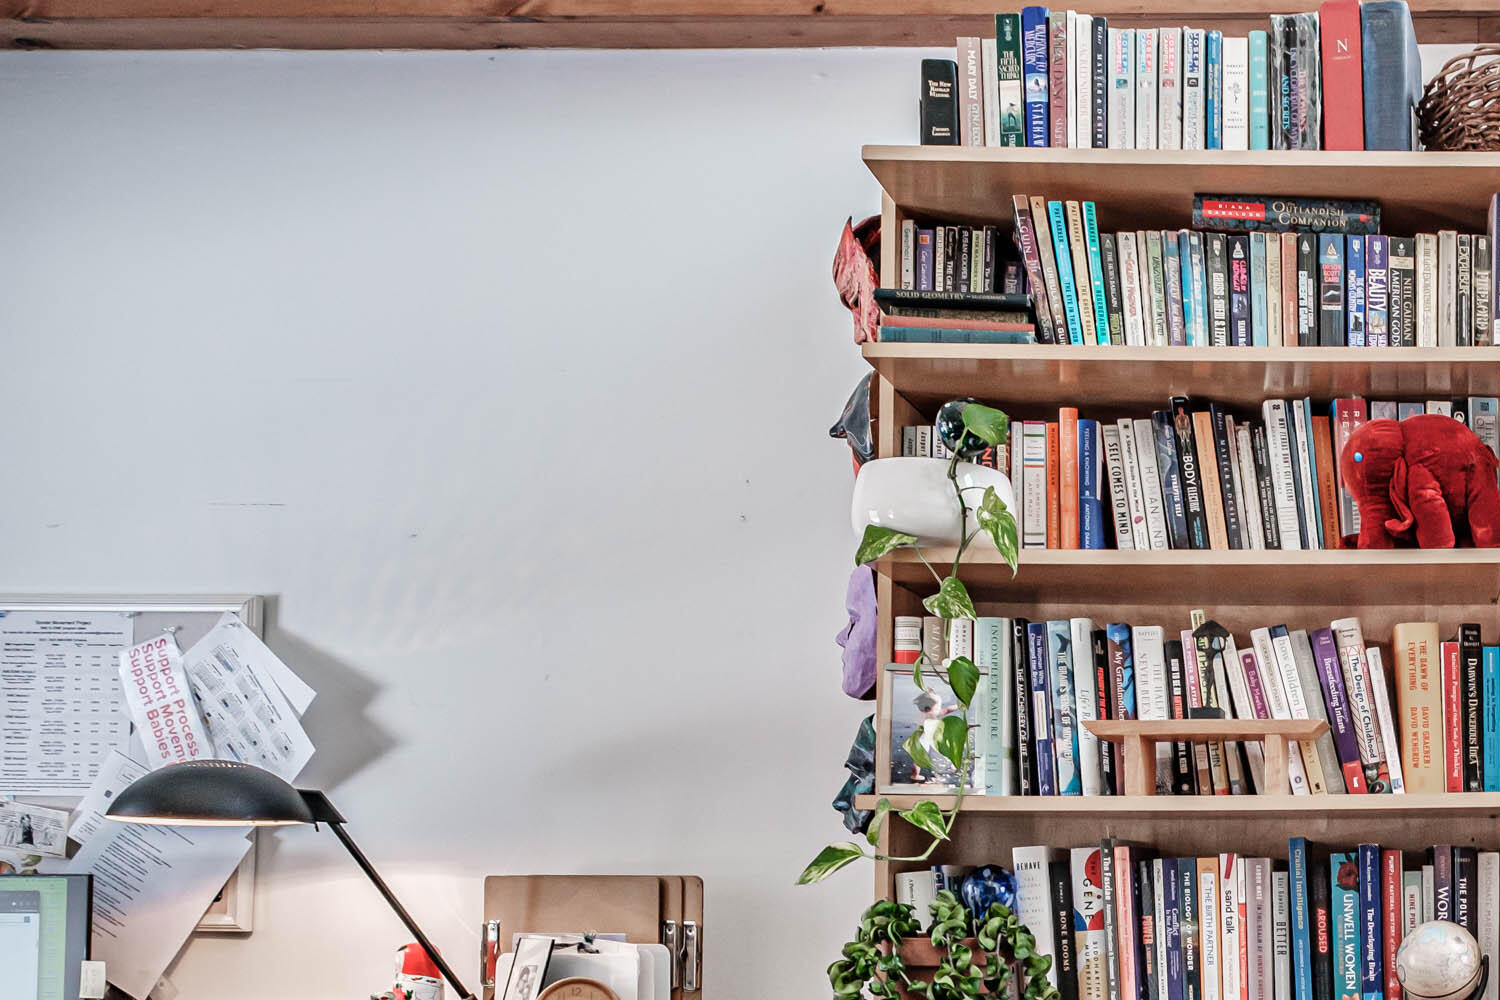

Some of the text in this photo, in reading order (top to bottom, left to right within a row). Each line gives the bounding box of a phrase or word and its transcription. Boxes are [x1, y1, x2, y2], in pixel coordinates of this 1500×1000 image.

[1025, 30, 1036, 66] MERCURY
[1035, 24, 1046, 71] WALKING TO
[1337, 38, 1348, 53] N
[968, 50, 976, 100] MARY DALY
[1032, 103, 1044, 146] STARHAW
[1272, 201, 1345, 216] OUTLANDISH
[1279, 213, 1346, 227] COMPANION
[1368, 268, 1386, 310] BEAUTY
[1459, 246, 1470, 294] EXCALIBUR
[1096, 290, 1106, 336] REGENERATION
[1391, 270, 1400, 346] AMERICAN GODS
[1404, 278, 1412, 340] NEIL GAIMAN
[1108, 442, 1128, 534] SELF COMES TO MIND
[1145, 466, 1164, 548] HUMANKIND
[1183, 455, 1200, 512] BODY ELECTRIC
[142, 643, 167, 702] Support
[154, 638, 181, 696] Support
[991, 624, 999, 740] INCOMPLETE NATURE
[1114, 651, 1123, 664] My
[1408, 642, 1417, 691] EVERYTHING
[1419, 640, 1428, 691] THE DAWN OF
[128, 648, 172, 759] Support Babies
[1324, 657, 1346, 733] Breastfeeding Infants
[1351, 657, 1377, 759] The Design of Childhood
[1467, 658, 1478, 765] DARWIN'S DANGEROUS IDEA
[1410, 707, 1419, 768] DAVID WENGROW
[1421, 706, 1430, 763] DAVID GRAEBER
[1083, 878, 1093, 919] GENE
[1184, 888, 1192, 921] BIOLOGY
[1225, 890, 1234, 934] sand talk
[1059, 911, 1070, 971] BONE ROOMS
[1186, 924, 1192, 934] OF
[1206, 930, 1214, 965] PARTNER
[1276, 921, 1287, 956] BETTER
[1317, 908, 1328, 953] AROUSED
[1343, 894, 1356, 989] UNWELL WOMEN
[1084, 944, 1092, 996] MUKHERJEE
